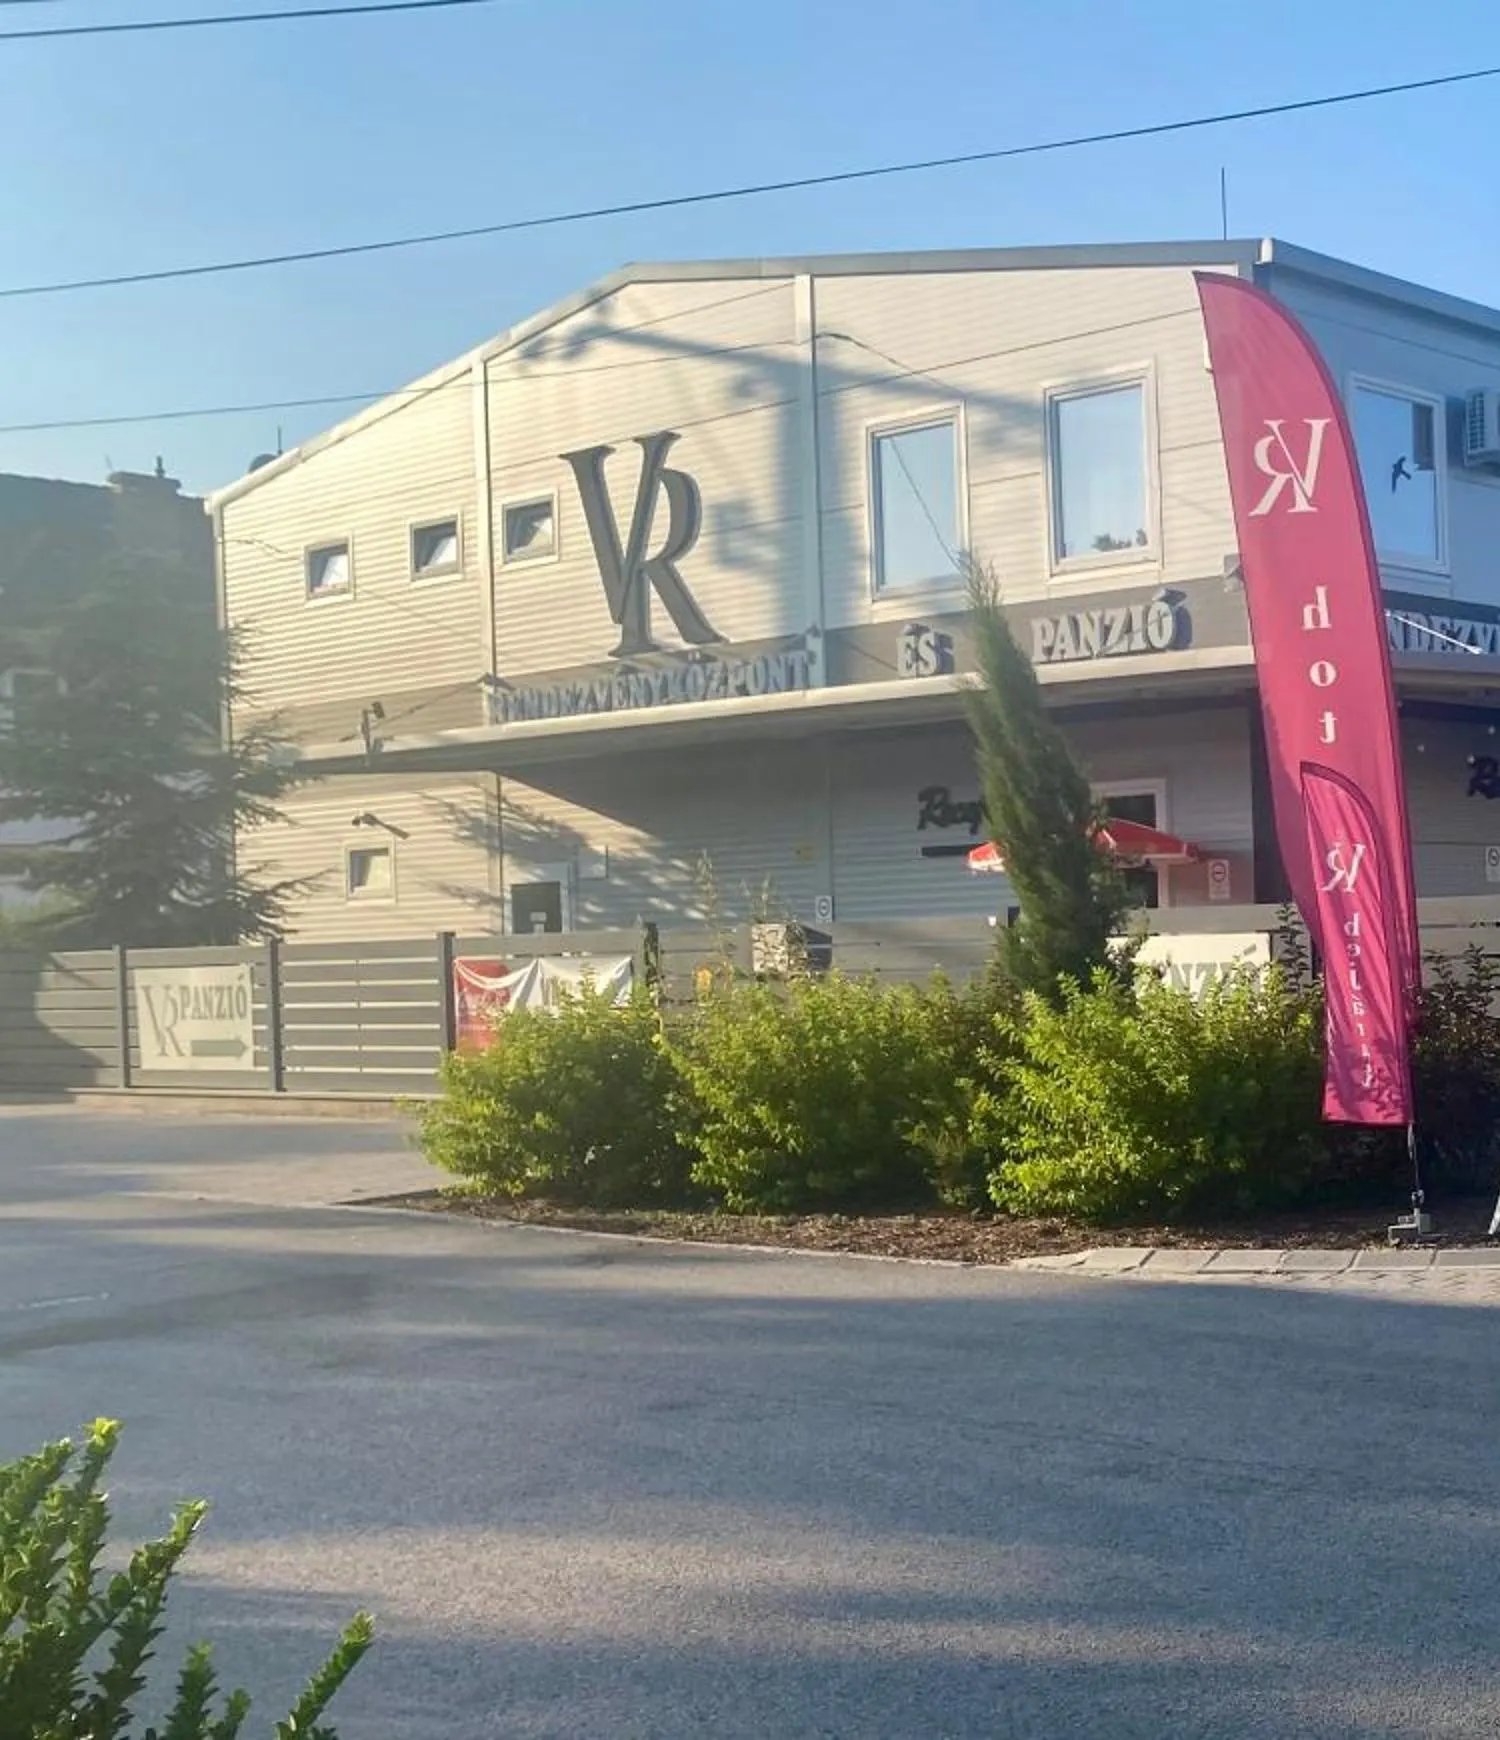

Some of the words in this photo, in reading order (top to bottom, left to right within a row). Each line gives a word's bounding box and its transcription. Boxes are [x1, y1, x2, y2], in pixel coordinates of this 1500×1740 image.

[559, 429, 730, 657] VR
[896, 624, 937, 677] ÉS
[1031, 588, 1174, 662] PANZIÓ
[140, 984, 186, 1057] VR
[179, 973, 248, 1021] PANZIÓ
